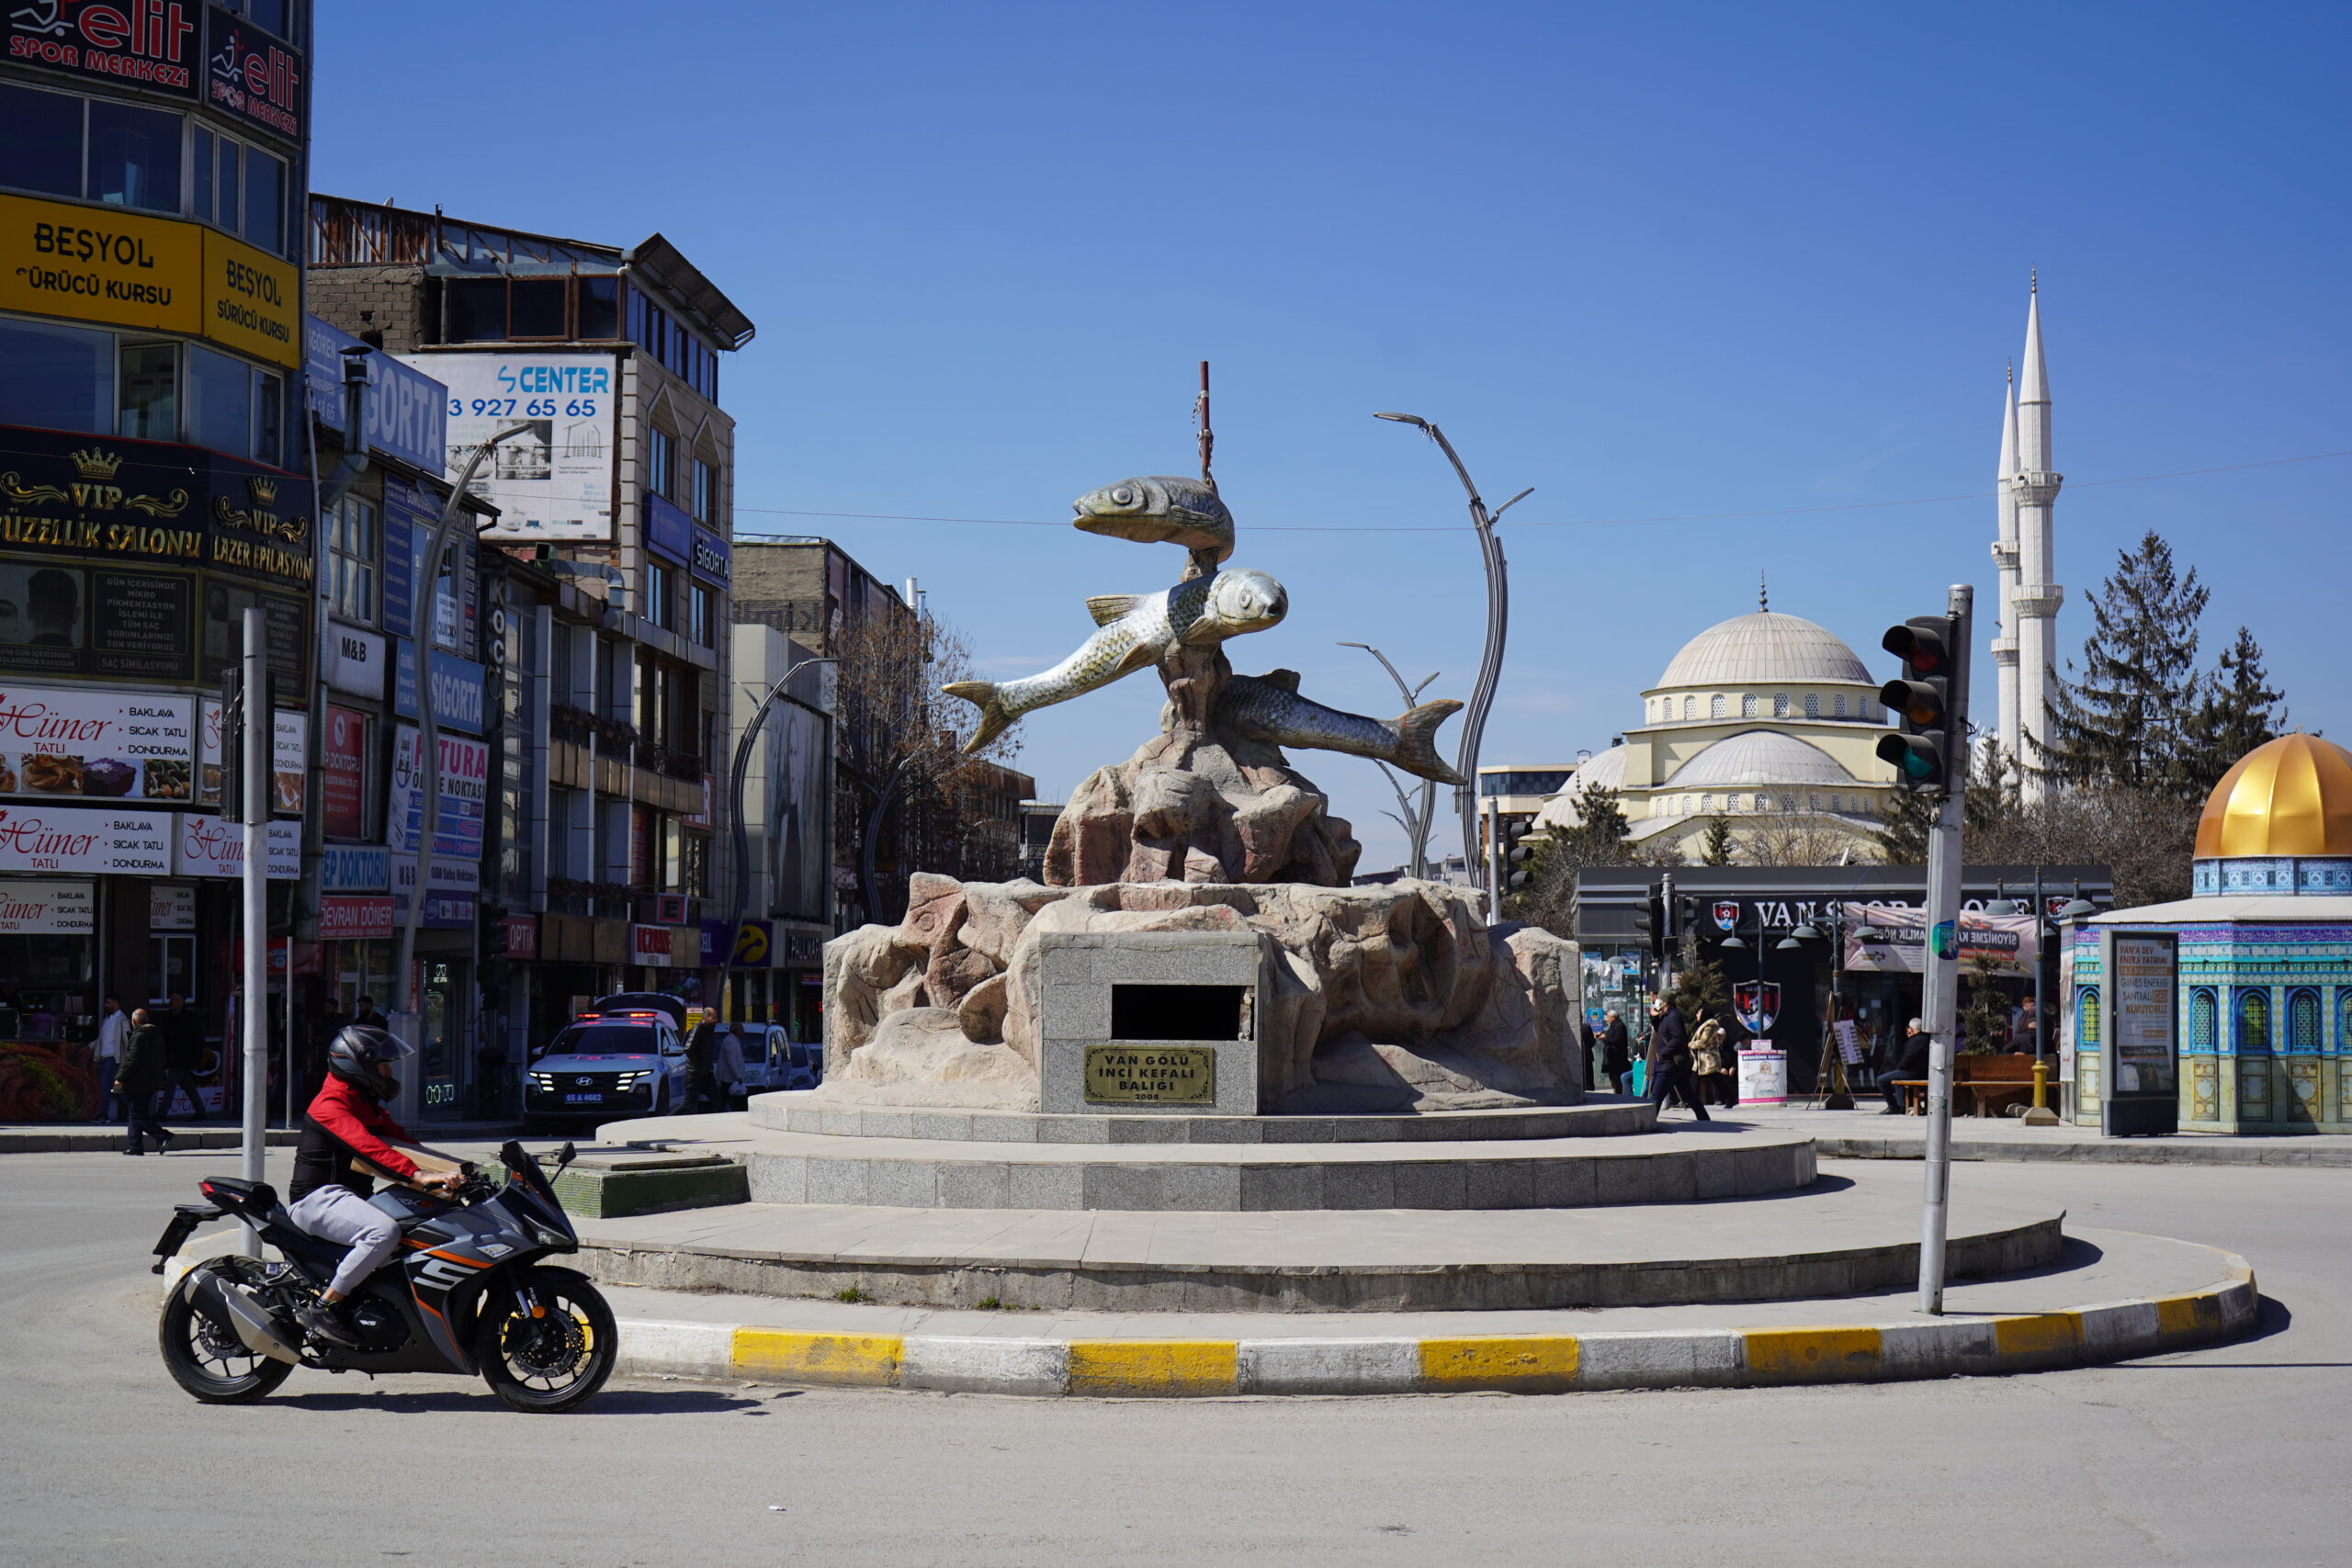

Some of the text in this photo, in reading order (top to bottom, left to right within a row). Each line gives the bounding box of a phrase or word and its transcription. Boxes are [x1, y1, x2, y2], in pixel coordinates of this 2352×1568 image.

[79, 0, 193, 62] elit
[9, 36, 78, 67] SPOR
[243, 45, 299, 111] elit
[211, 79, 245, 109] SPOR
[34, 222, 154, 268] BEŞYOL
[106, 279, 171, 306] KURSU
[226, 259, 281, 307] BEŞYOL
[217, 299, 289, 344] SÜRÜCÜ KURSU
[520, 366, 608, 393] CENTER
[340, 346, 442, 464] GORTA
[471, 399, 516, 417] 927
[526, 399, 557, 417] 65
[565, 399, 596, 417] 65
[68, 482, 122, 510] VIP
[0, 506, 202, 558] ÜZELLİK SALONU
[250, 509, 277, 536] VIP
[212, 535, 250, 569] LAZER
[696, 538, 729, 580] SİGORTA
[127, 589, 155, 598] MİKRO
[122, 619, 160, 630] TÜM SAÇ
[107, 639, 126, 648] SON
[341, 637, 367, 662] M&B
[101, 658, 119, 668] SAÇ
[430, 662, 483, 725] SİGORTA
[0, 703, 112, 741] Hüner
[129, 706, 175, 718] BAKLAVA
[129, 726, 187, 738] SICAK TATLI
[33, 742, 65, 754] TATLI
[128, 745, 188, 756] DONDURMA
[413, 734, 486, 780] FTURA
[330, 752, 361, 773] DOKTORU
[447, 777, 485, 800] NOKTASI
[0, 818, 99, 856] Hüner
[113, 820, 153, 831] BAKLAVA
[113, 840, 163, 851] SICAK TATLI
[185, 827, 244, 861] Hün
[31, 857, 59, 869] TATLI
[112, 859, 164, 869] DONDURMA
[218, 863, 235, 874] TATLI
[322, 851, 389, 887] EP DOKTORU
[57, 906, 75, 914] SICAK
[360, 901, 391, 925] DÖNER
[1754, 901, 1816, 928] VAN
[1, 921, 20, 930] TATLI
[2142, 946, 2154, 954] DEV
[1099, 1066, 1194, 1078] İNCİ KEFALİ
[1104, 1054, 1189, 1066] VAN GÖLÜ
[1119, 1079, 1174, 1091] BALIĞI
